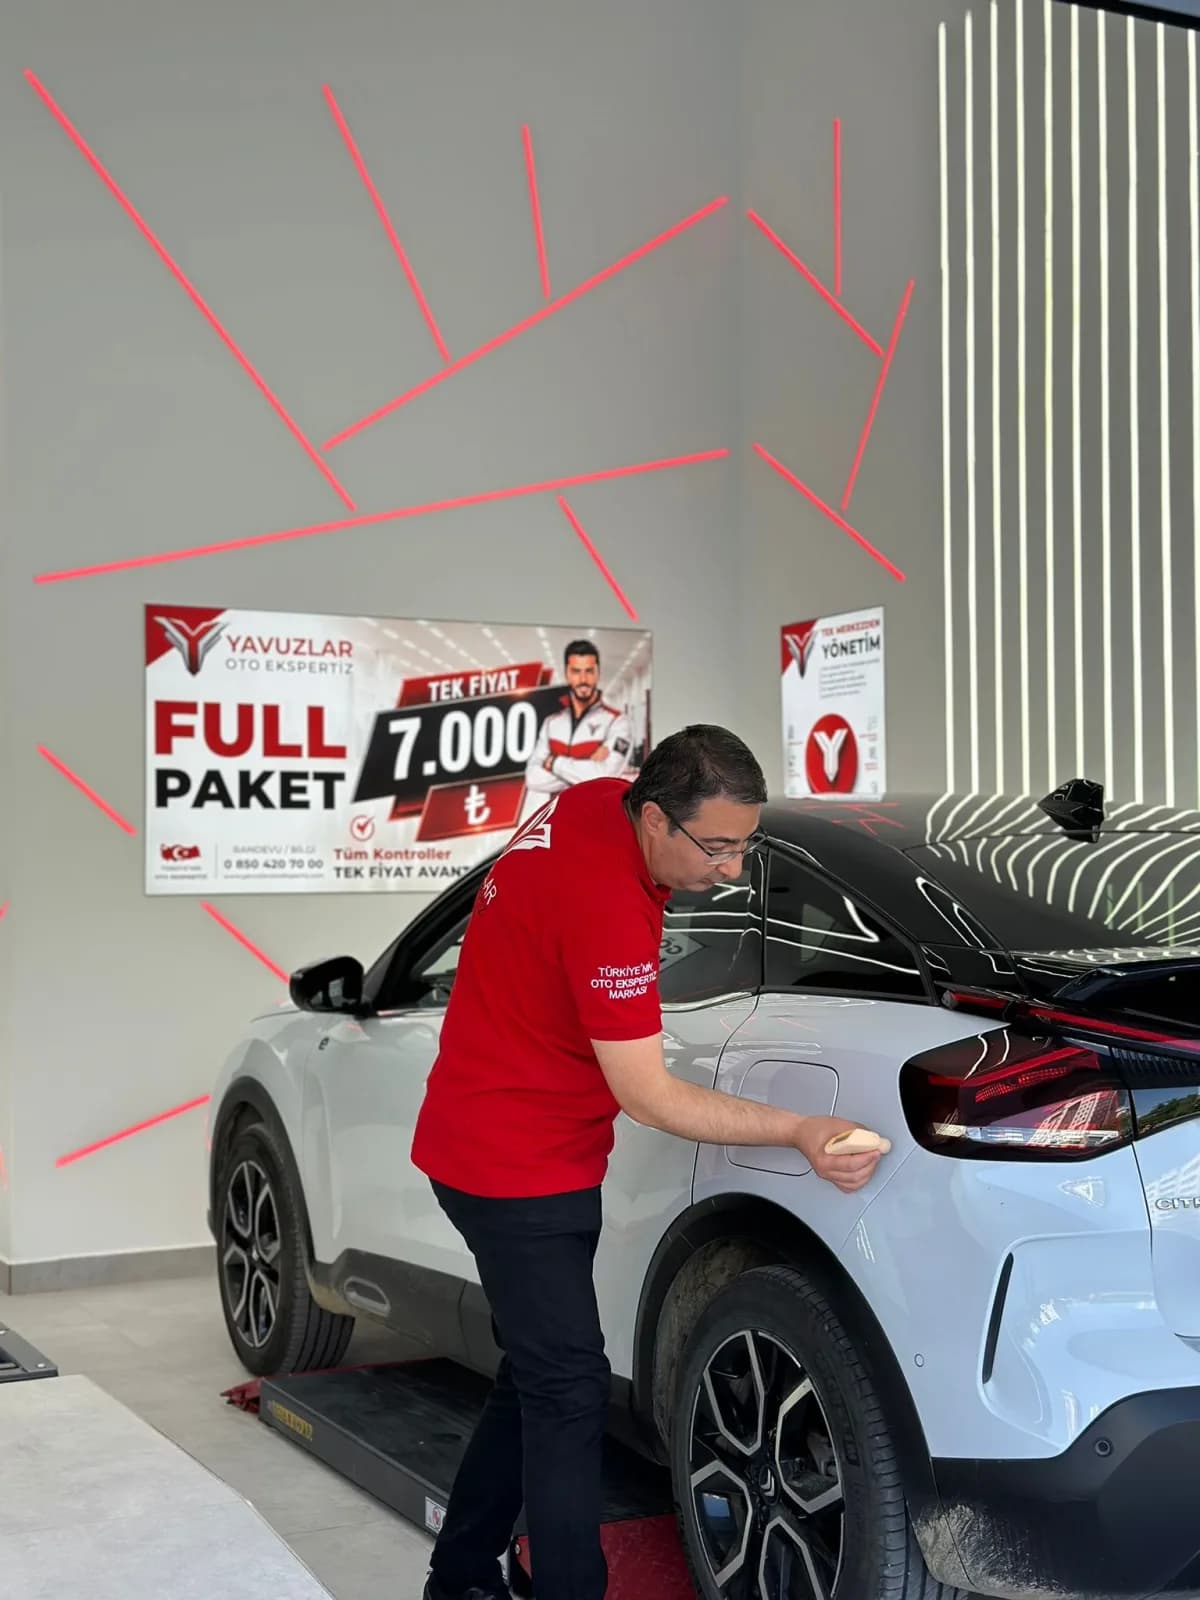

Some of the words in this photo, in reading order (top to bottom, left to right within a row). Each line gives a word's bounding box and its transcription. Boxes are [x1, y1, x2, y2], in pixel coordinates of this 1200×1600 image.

[226, 635, 354, 658] YAVUZLAR
[822, 631, 880, 660] YÖNETİM
[225, 658, 260, 671] OTO
[266, 659, 354, 675] EKSPERTİZ
[428, 680, 464, 702] TEK
[469, 668, 520, 697] FİYAT
[155, 700, 347, 759] FULL
[388, 701, 538, 781] 7.000
[155, 768, 345, 810] PAKET
[224, 859, 232, 869] 0
[236, 859, 259, 869] 850
[263, 859, 286, 869] 420
[288, 859, 304, 869] 70
[307, 859, 324, 869] 00
[334, 848, 368, 861] Tüm
[373, 848, 452, 861] Kontroller
[334, 867, 363, 879] TEK
[370, 863, 413, 879] FİYAT
[590, 979, 613, 989] OTO
[609, 985, 648, 999] MARKASI
